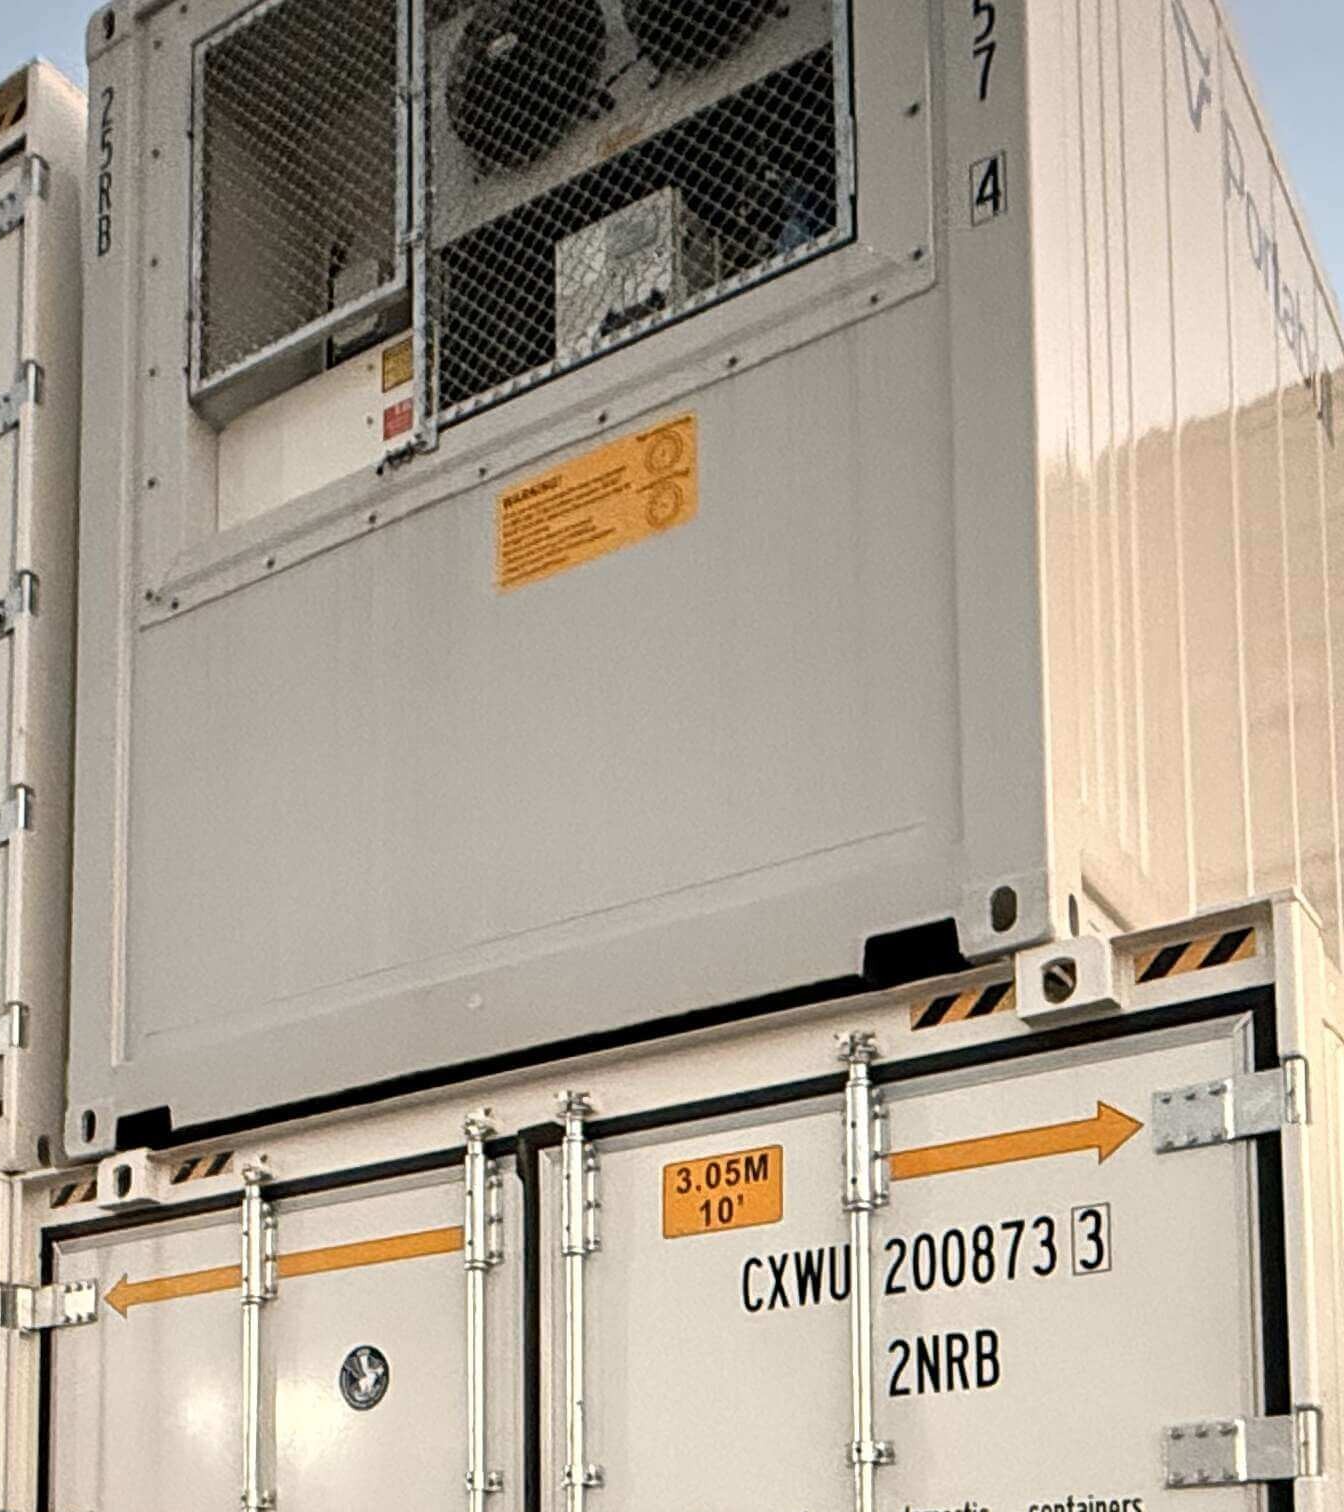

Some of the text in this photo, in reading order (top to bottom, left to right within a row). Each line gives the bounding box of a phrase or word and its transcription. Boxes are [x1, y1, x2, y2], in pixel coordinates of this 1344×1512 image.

[97, 86, 114, 257] 25RB
[675, 1152, 770, 1194] 3.05M
[742, 1208, 1104, 1312] CXWU 200873 3
[888, 1329, 1001, 1397] 2NRB
